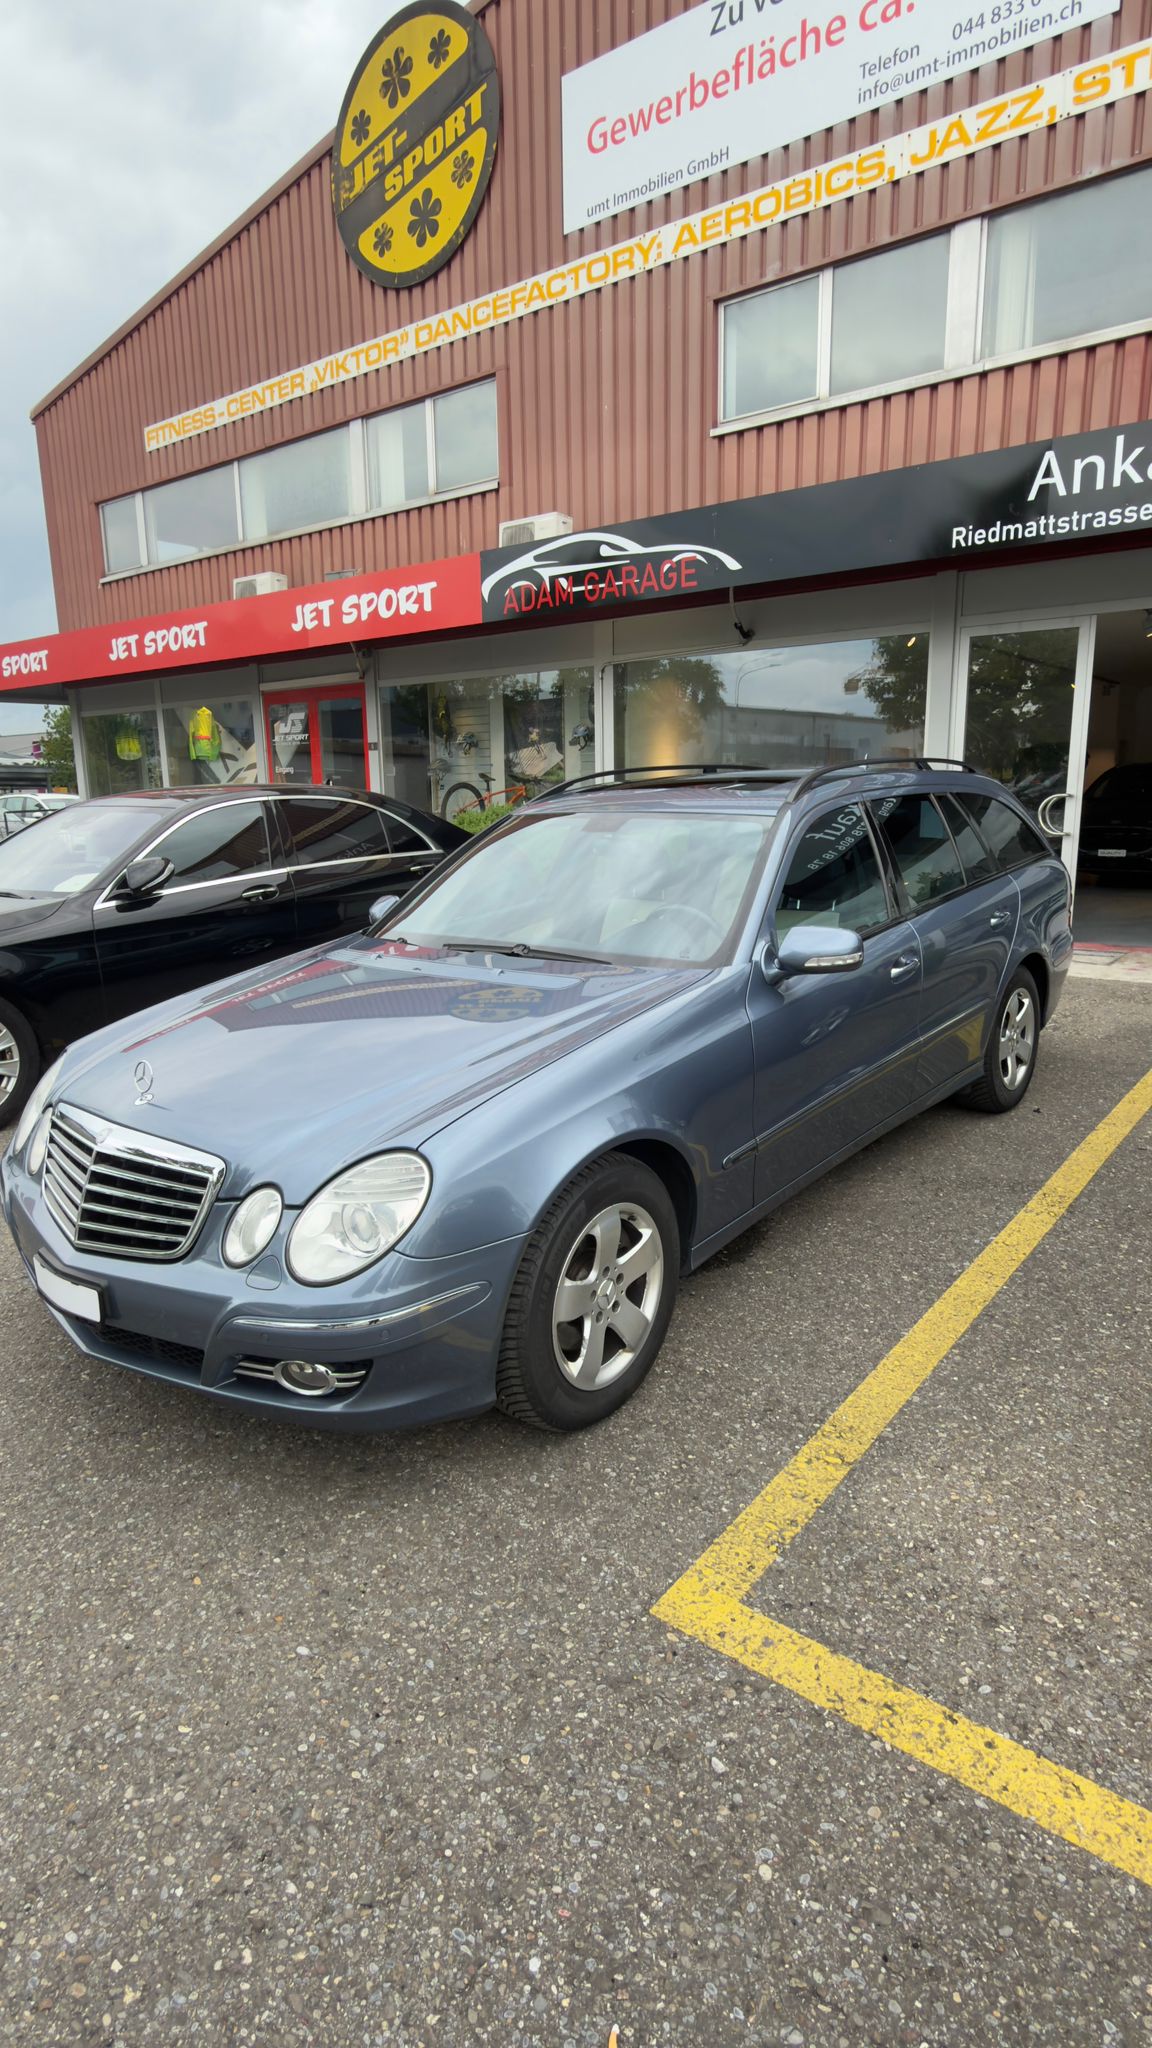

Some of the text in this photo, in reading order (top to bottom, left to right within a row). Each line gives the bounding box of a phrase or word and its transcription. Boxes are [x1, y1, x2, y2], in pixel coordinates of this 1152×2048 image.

[710, 0, 744, 36] Zu
[860, 0, 1024, 80] Telefon 044 833
[587, 0, 915, 154] Gewerbefläche ca.
[858, 0, 1083, 104] info@umt-immobilien.ch
[384, 83, 488, 202] SPORT
[672, 148, 896, 254] AEROBICS,
[910, 86, 1057, 167] JAZZ,
[1072, 47, 1152, 106] ST
[587, 146, 730, 218] umt Immobilien GmbH
[1027, 434, 1152, 502] Ank
[952, 502, 1152, 549] Riedmattstrasse
[290, 581, 438, 632] JET SPORT
[503, 555, 699, 616] ADAM GARAGE
[1, 650, 49, 677] SPORT
[108, 621, 208, 661] JET SPORT
[285, 733, 310, 741] SPORT
